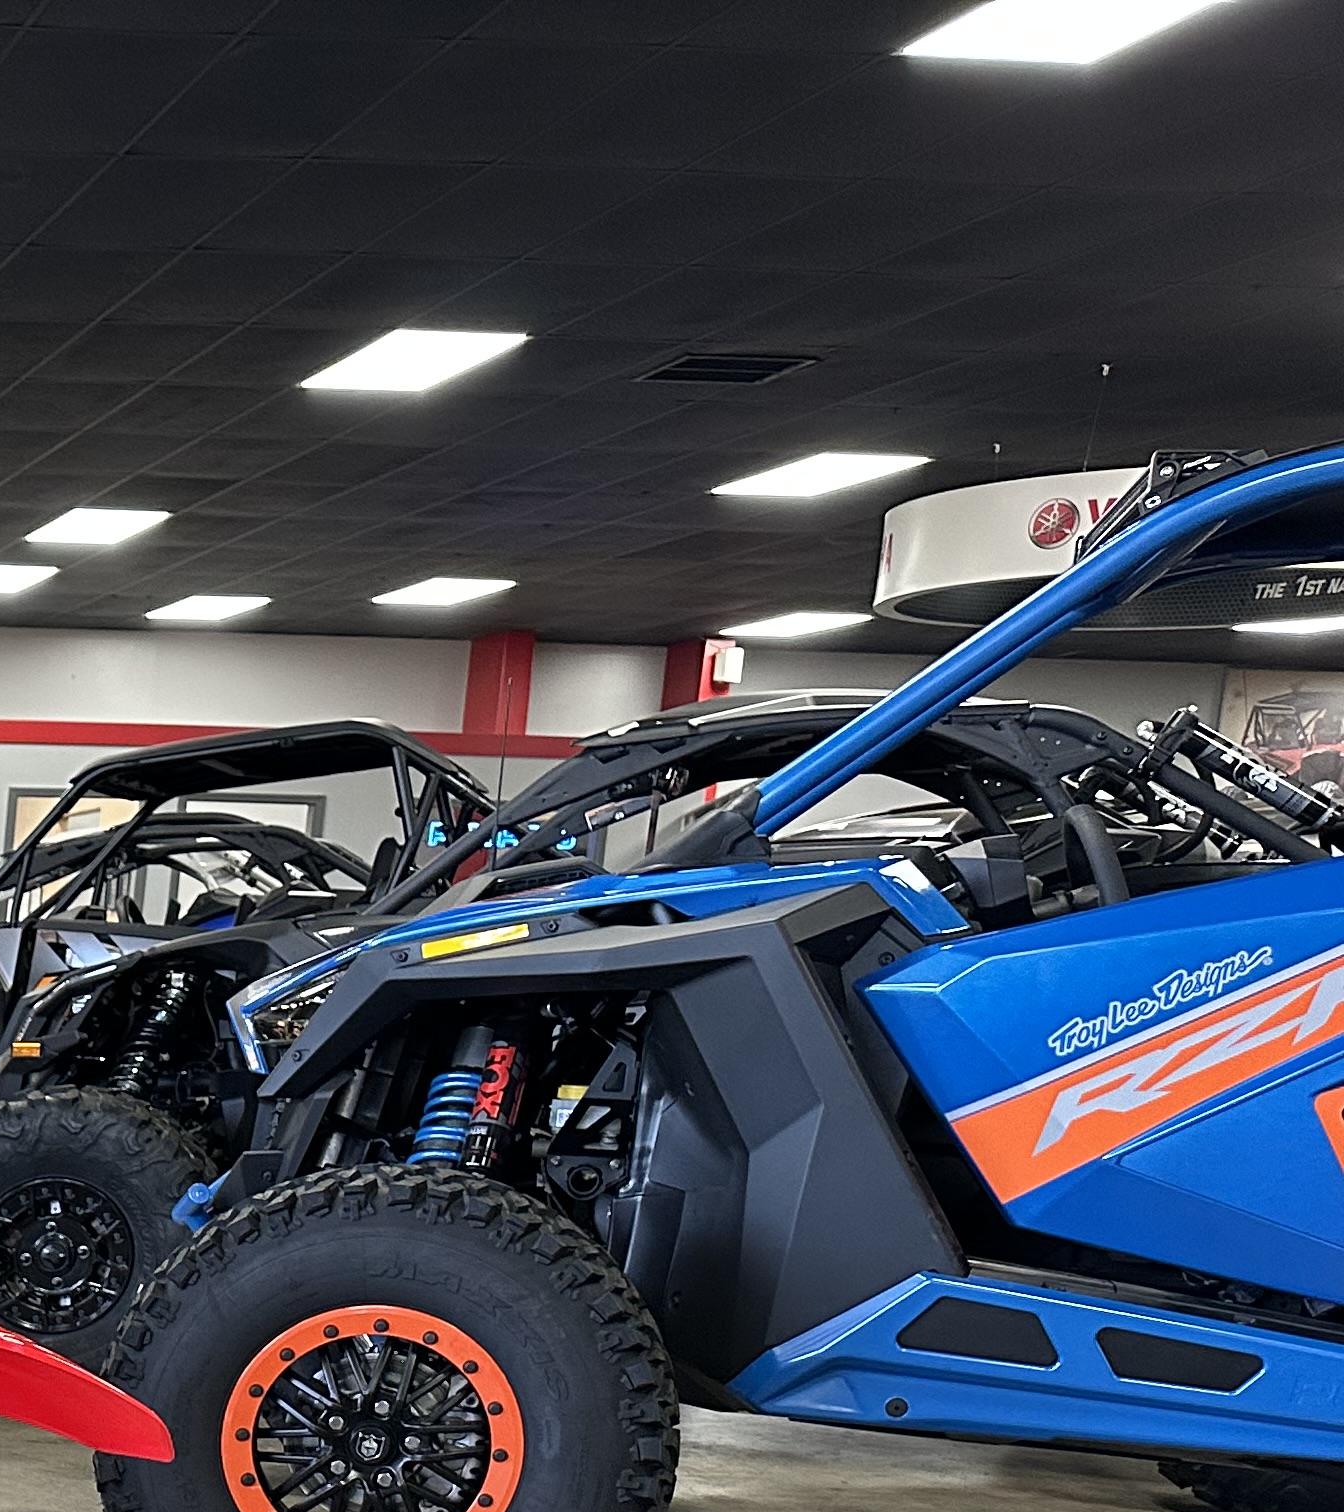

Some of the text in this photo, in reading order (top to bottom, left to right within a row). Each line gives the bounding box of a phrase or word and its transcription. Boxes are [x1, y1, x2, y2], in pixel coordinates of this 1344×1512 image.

[1255, 582, 1287, 600] THE
[1296, 575, 1326, 597] 1ST
[1048, 945, 1273, 1056] Troy Lee Designs
[470, 1046, 518, 1120] FOX
